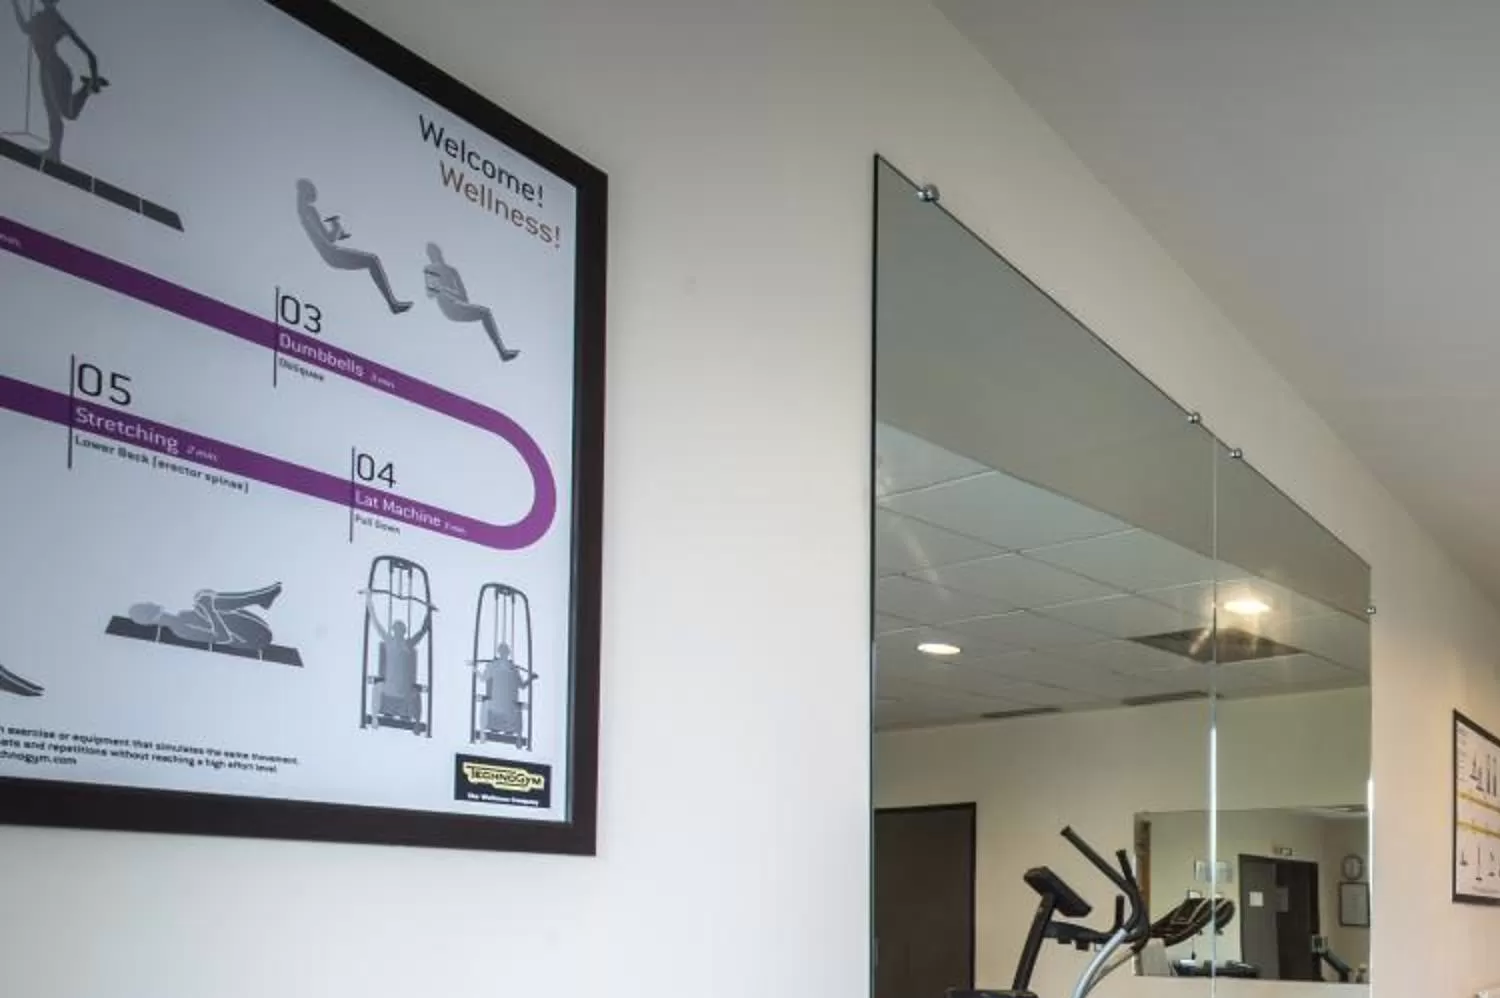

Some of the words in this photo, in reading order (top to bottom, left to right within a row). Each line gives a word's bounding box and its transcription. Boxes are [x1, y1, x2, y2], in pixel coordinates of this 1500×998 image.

[418, 112, 544, 209] Welcome!
[439, 159, 561, 249] Wellness!
[280, 294, 322, 334] 03
[279, 333, 364, 377] Dumbbells
[77, 362, 133, 407] 05
[74, 434, 115, 455] Lower
[75, 406, 180, 456] Stretching
[356, 452, 396, 489] 04
[354, 489, 379, 509] Lat
[383, 497, 441, 527] Machine
[8, 726, 55, 739] exercise
[58, 732, 70, 740] or
[72, 731, 129, 748] equipment
[132, 738, 152, 749] that
[23, 740, 45, 751] and
[47, 742, 107, 757] repetitions
[110, 748, 149, 761] without
[151, 752, 194, 769] reaching
[205, 757, 226, 771] high
